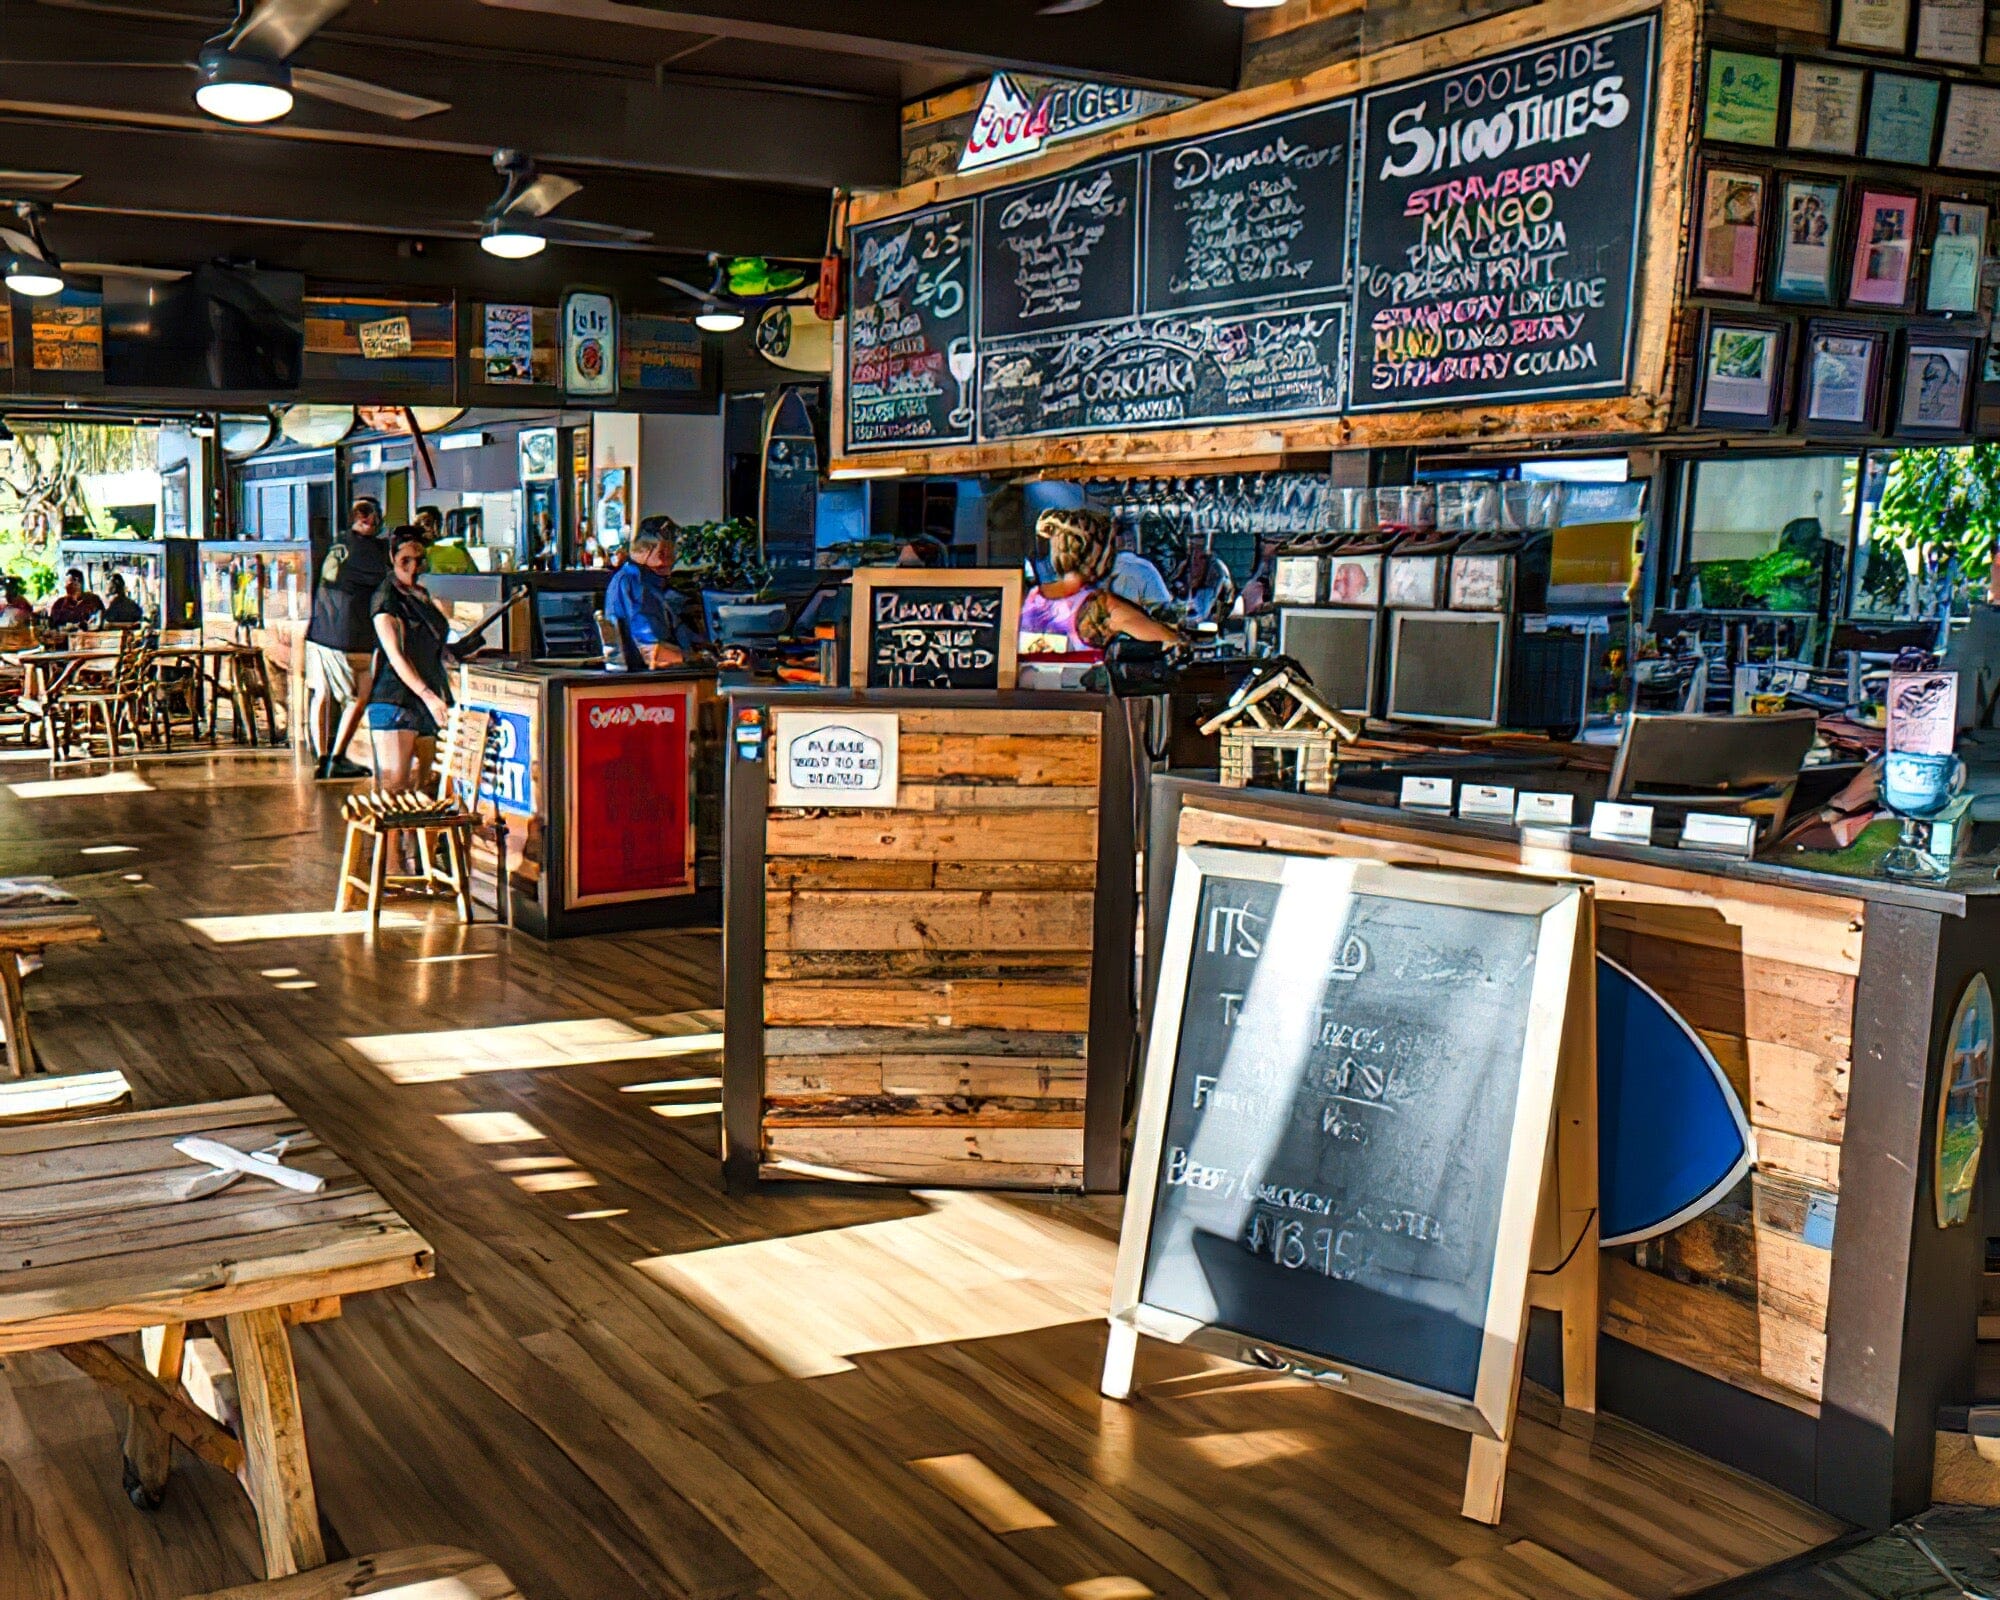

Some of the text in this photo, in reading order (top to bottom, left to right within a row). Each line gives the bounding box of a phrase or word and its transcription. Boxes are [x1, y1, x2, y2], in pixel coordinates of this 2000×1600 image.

[1443, 35, 1615, 114] POOLSIDE
[1404, 152, 1592, 216] STRAWBERRY
[1420, 190, 1553, 249] MANGO
